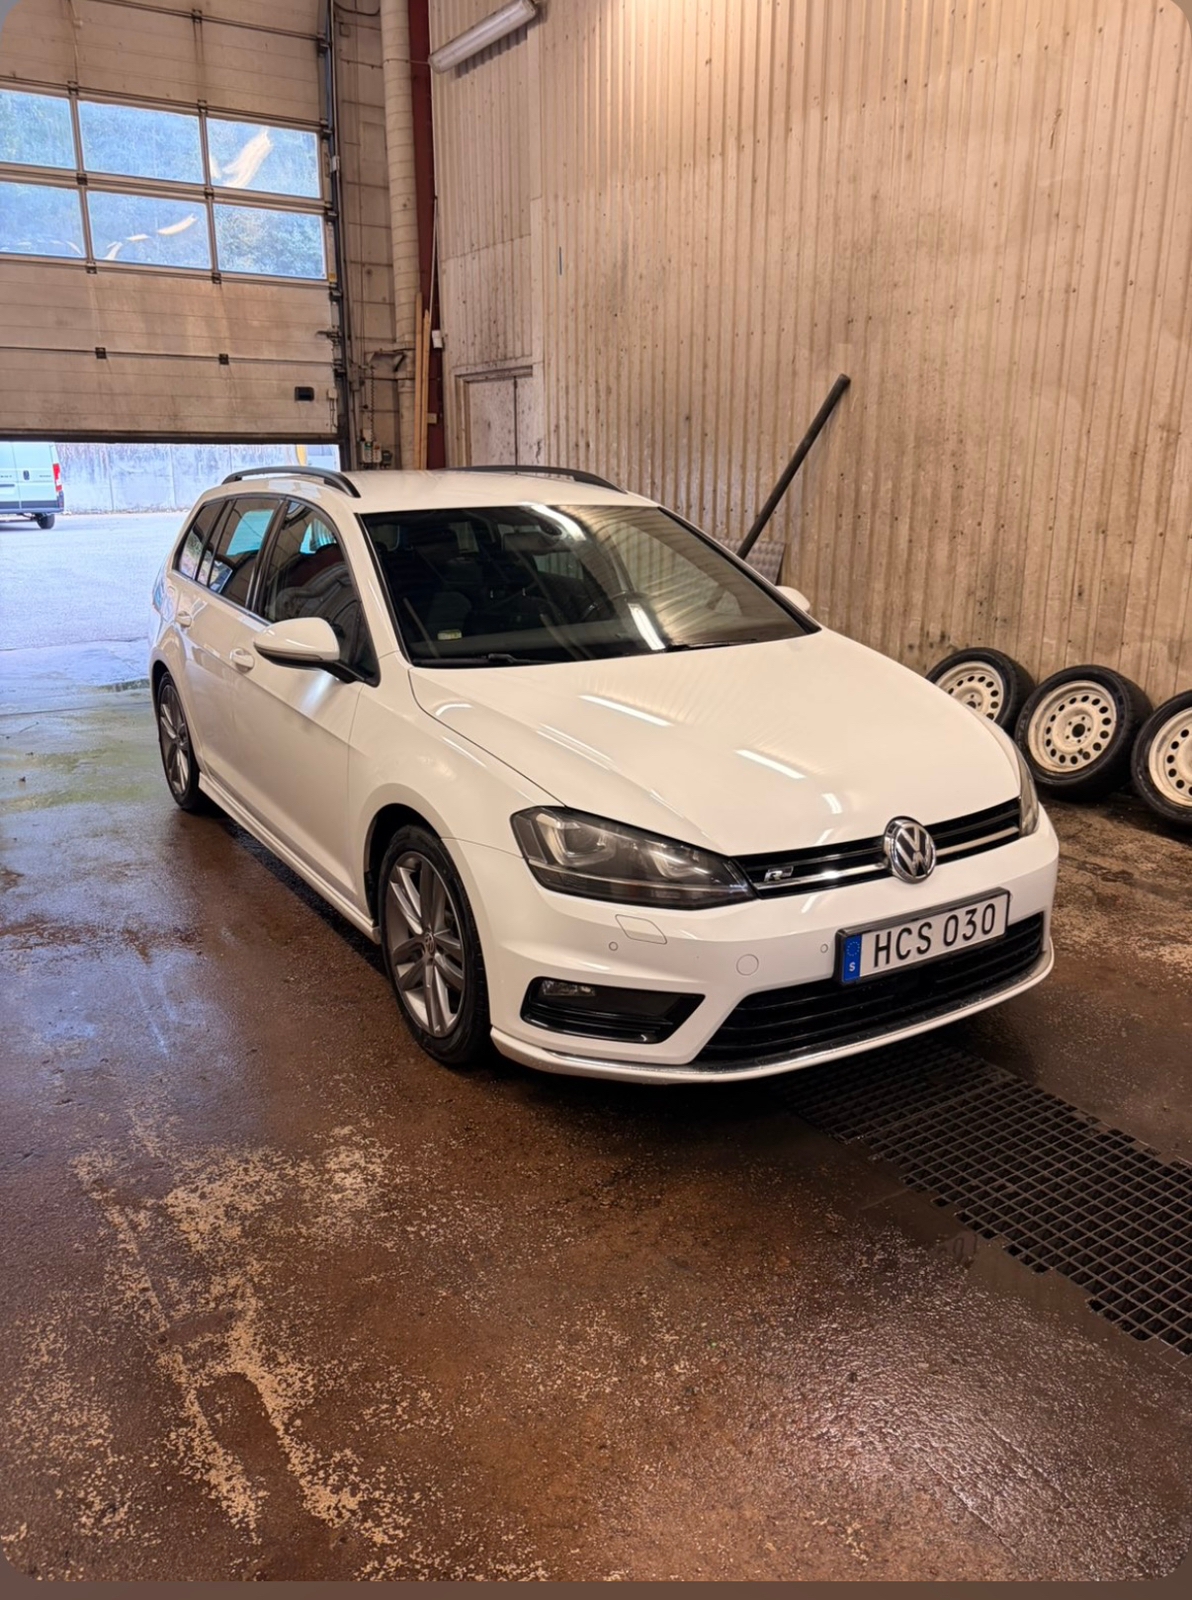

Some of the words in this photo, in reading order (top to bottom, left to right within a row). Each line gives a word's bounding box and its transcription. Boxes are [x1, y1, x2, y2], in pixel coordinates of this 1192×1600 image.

[873, 921, 933, 968] HCS
[943, 903, 996, 947] 030
[849, 961, 856, 972] S
